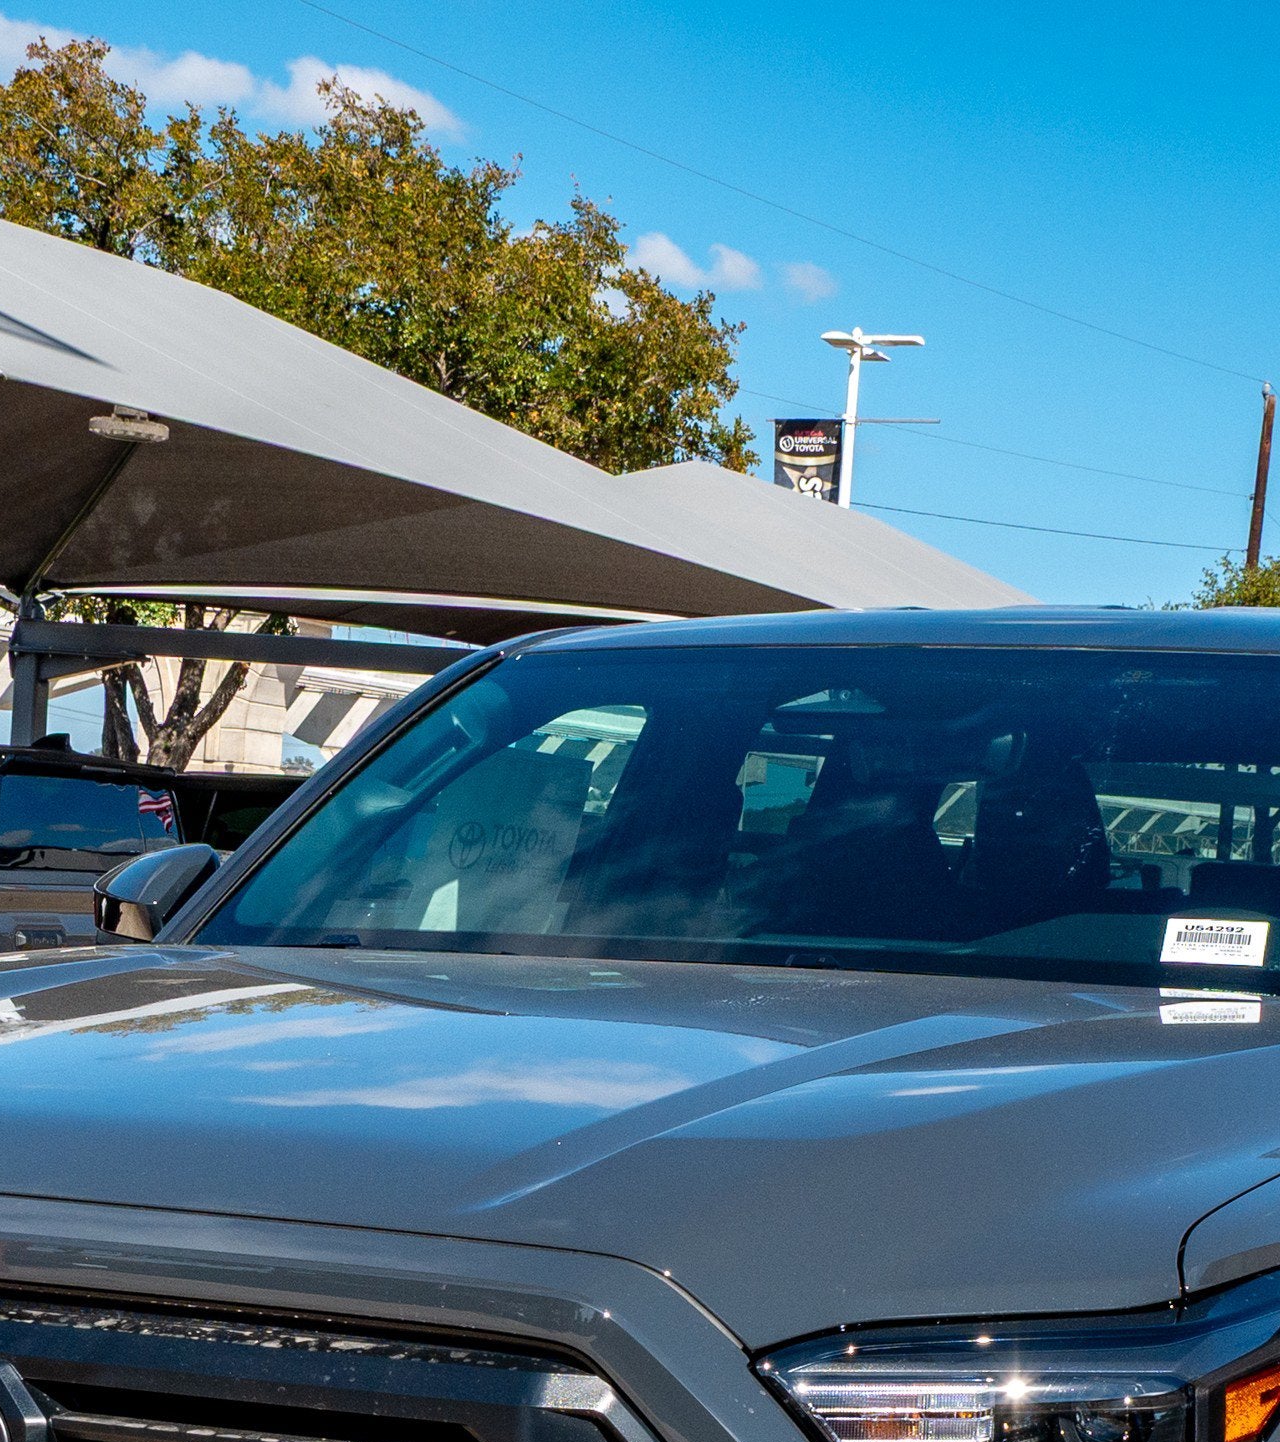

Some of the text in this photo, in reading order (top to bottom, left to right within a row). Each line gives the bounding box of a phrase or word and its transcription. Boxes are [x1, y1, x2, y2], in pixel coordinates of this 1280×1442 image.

[794, 436, 837, 445] UNIVERSAL
[795, 444, 825, 452] TOYOTA
[490, 823, 557, 857] TOYOTA
[1184, 924, 1245, 933] U54292
